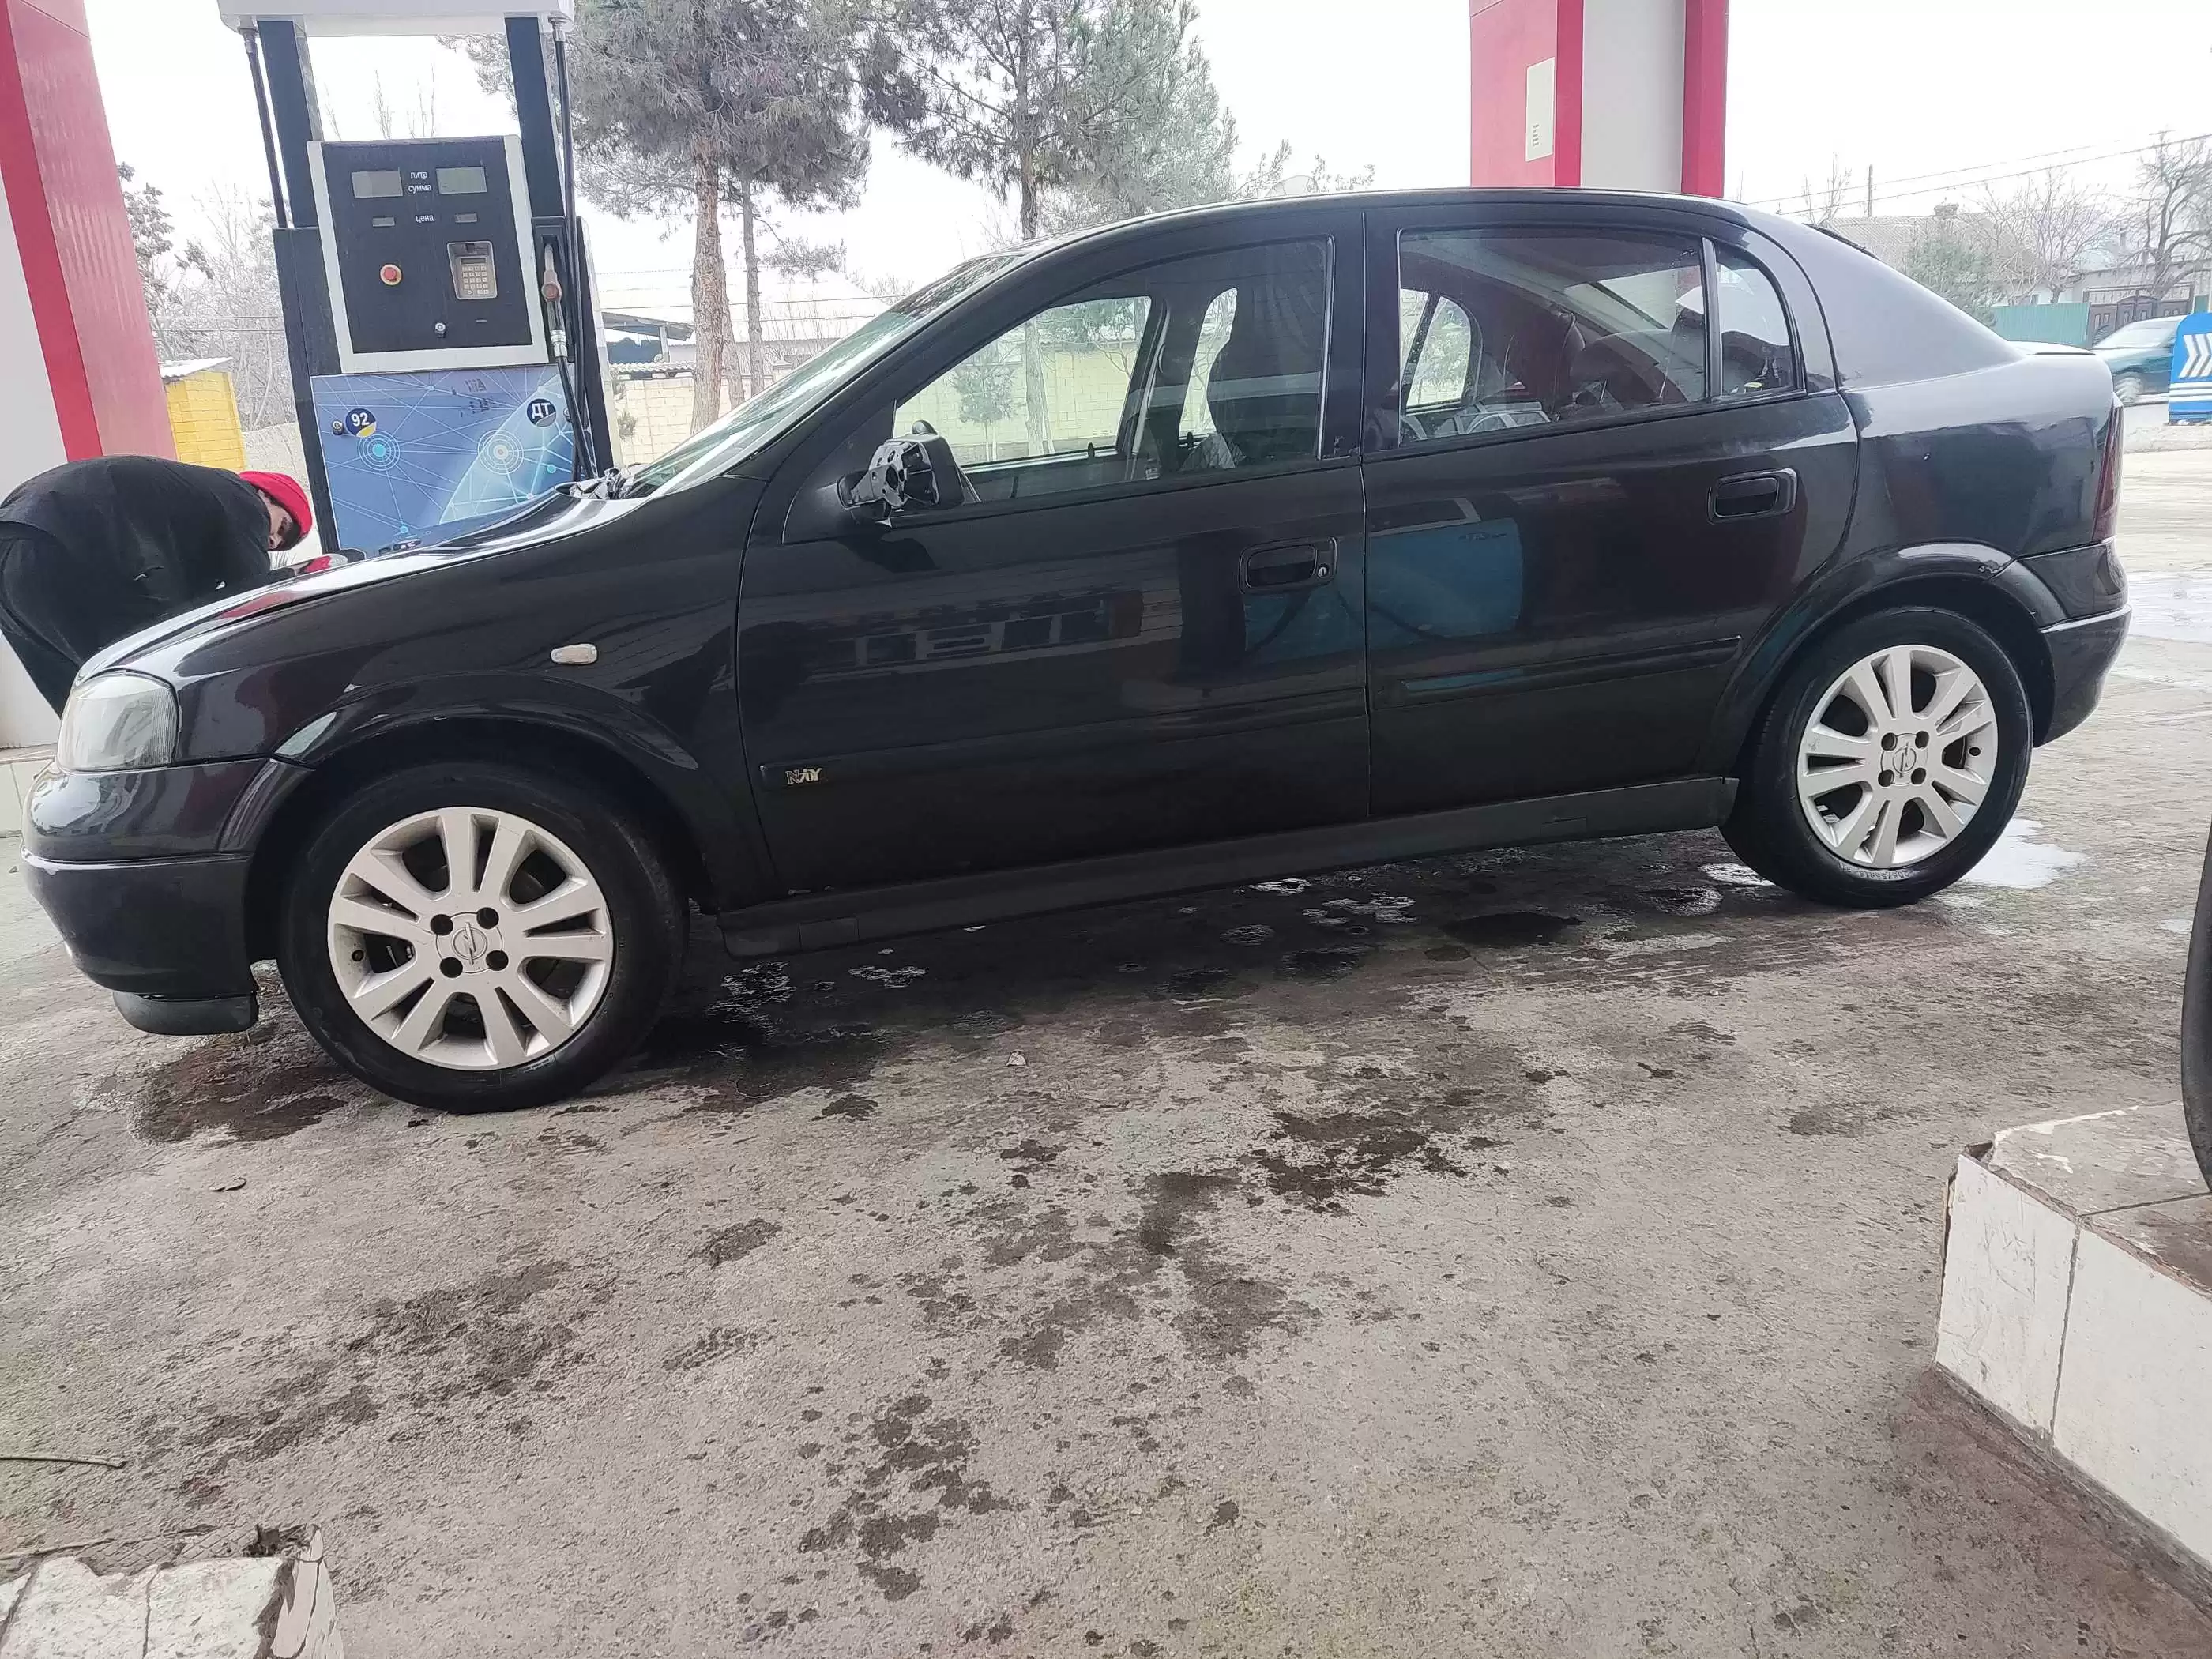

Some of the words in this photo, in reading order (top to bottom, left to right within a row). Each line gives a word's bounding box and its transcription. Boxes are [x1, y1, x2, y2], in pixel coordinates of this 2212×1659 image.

[408, 184, 432, 194] сумма
[416, 215, 434, 224] цена
[532, 402, 551, 419] ДТ
[351, 412, 371, 427] 92
